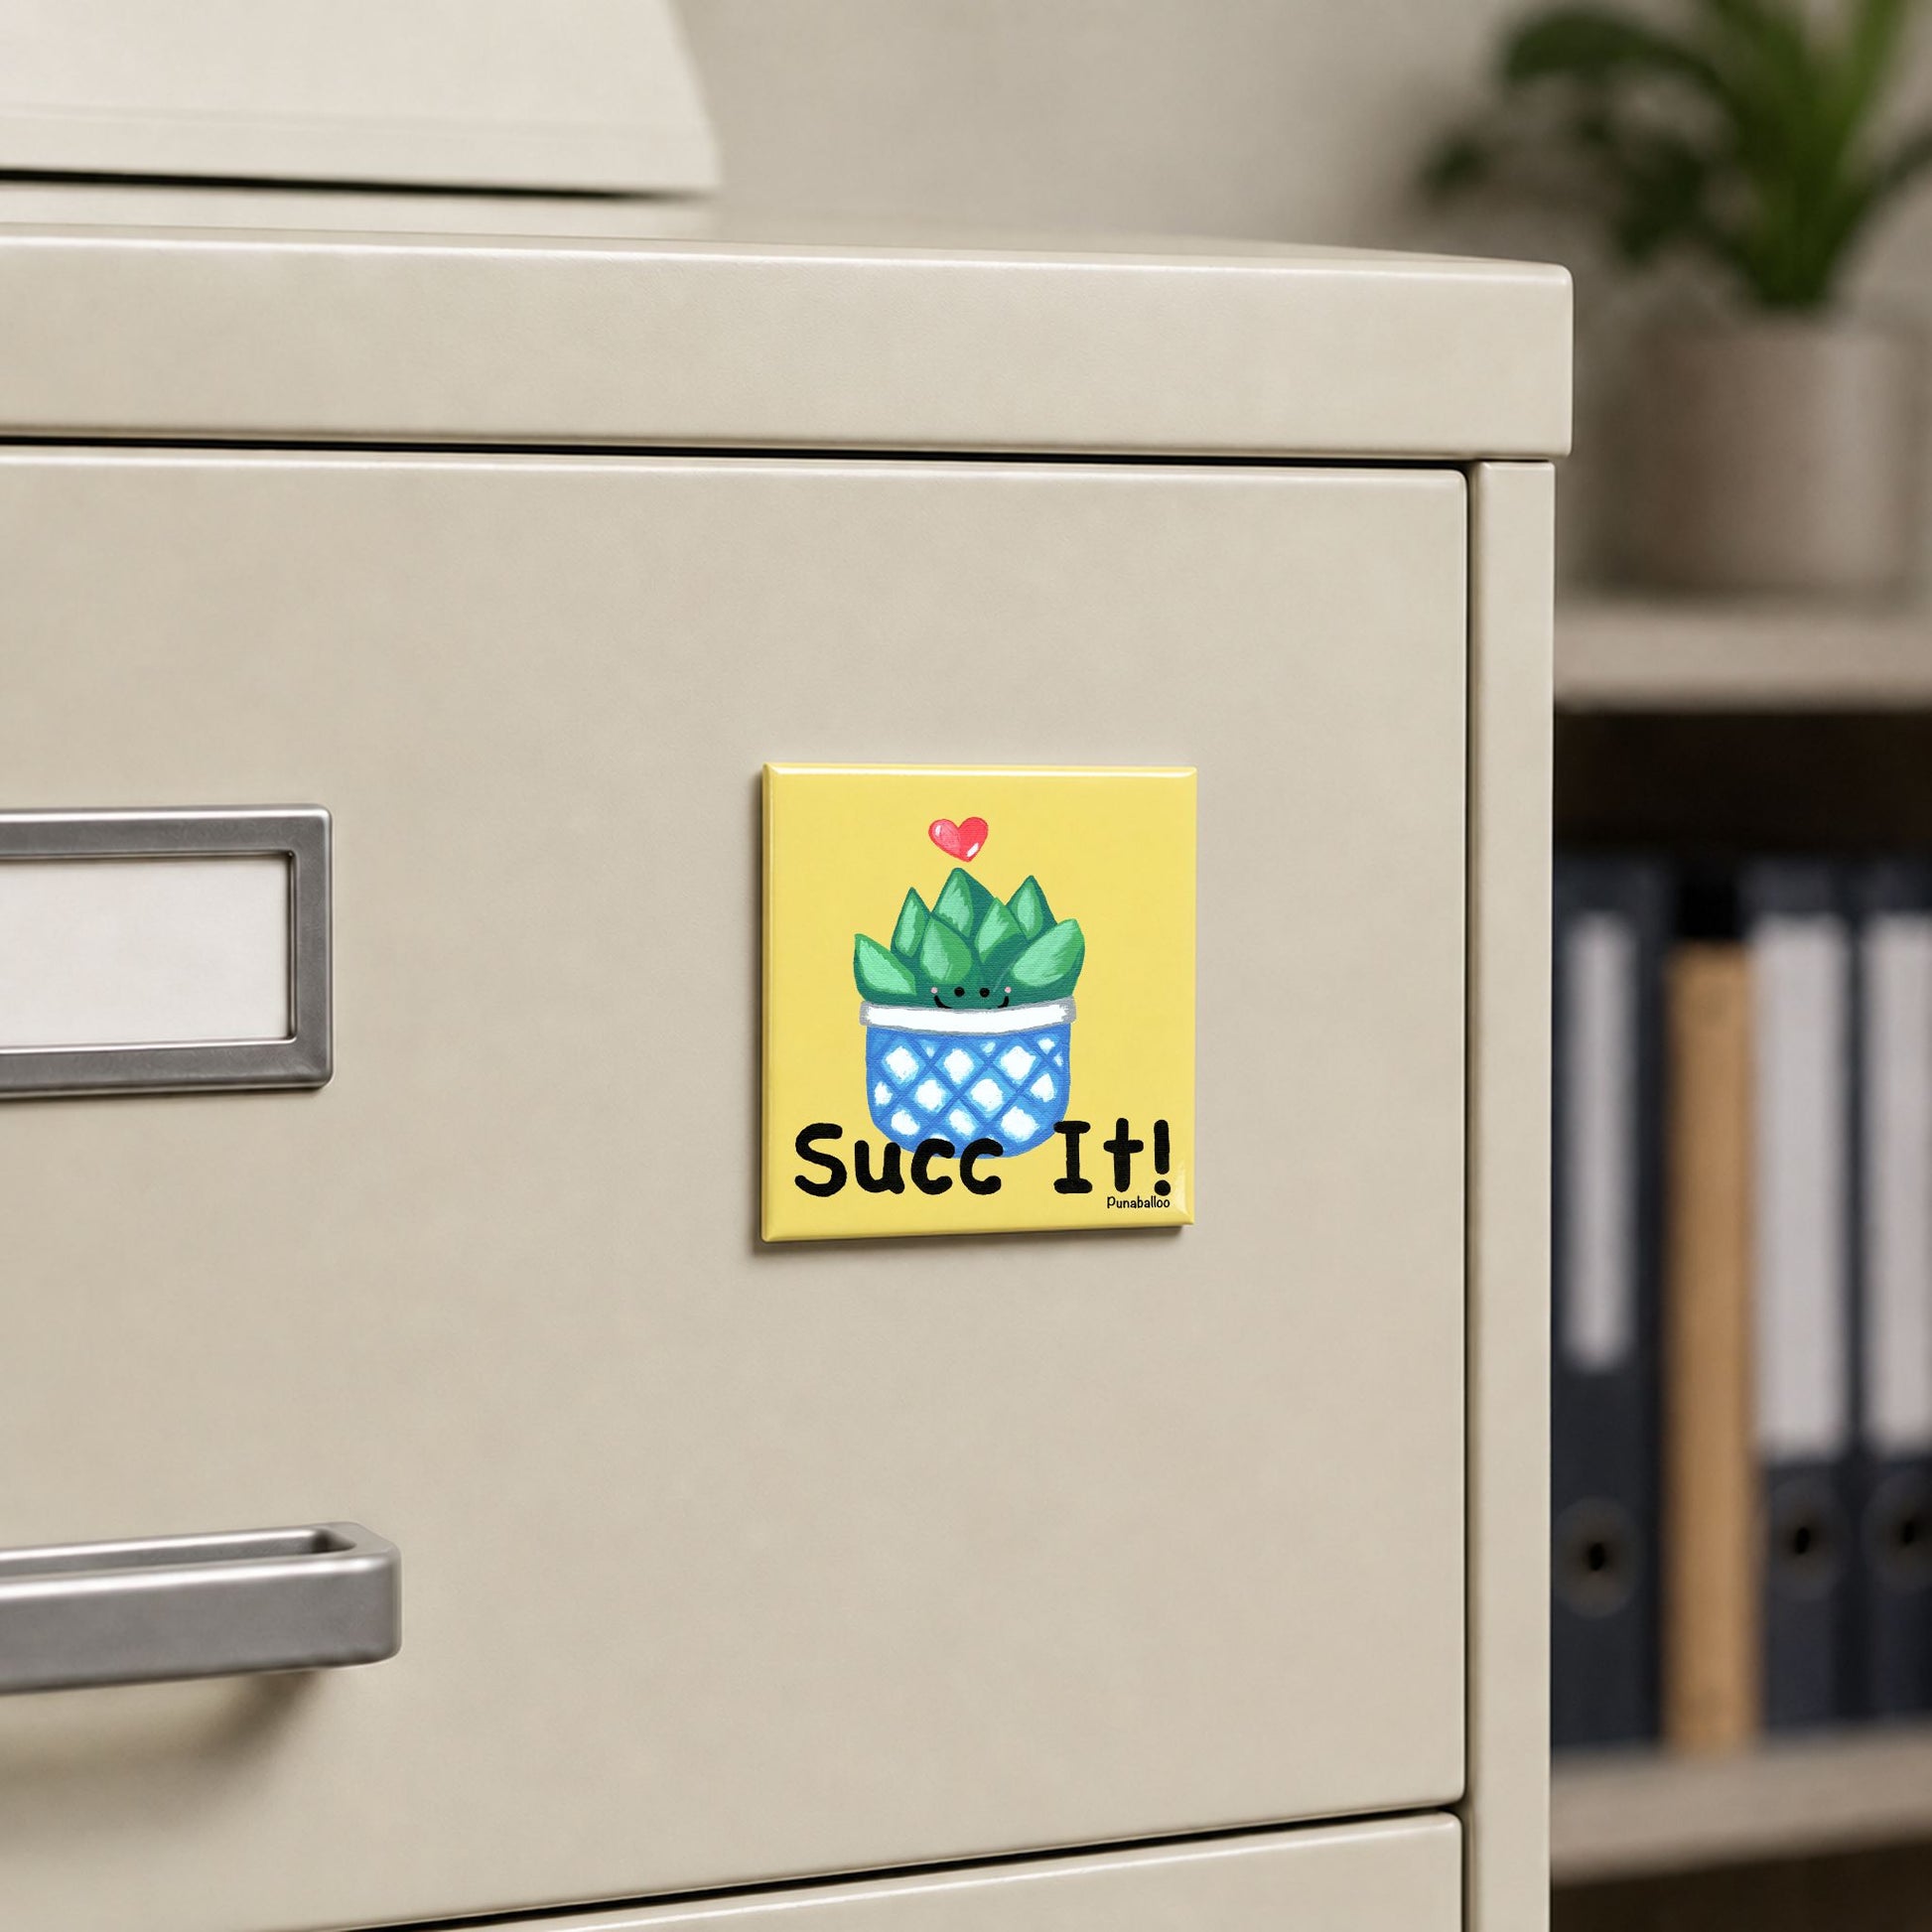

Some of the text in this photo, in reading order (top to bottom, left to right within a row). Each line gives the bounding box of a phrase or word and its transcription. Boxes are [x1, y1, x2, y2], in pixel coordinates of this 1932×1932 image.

[794, 1117, 1172, 1197] Succ It!
[1106, 1194, 1171, 1209] Punaballoo
